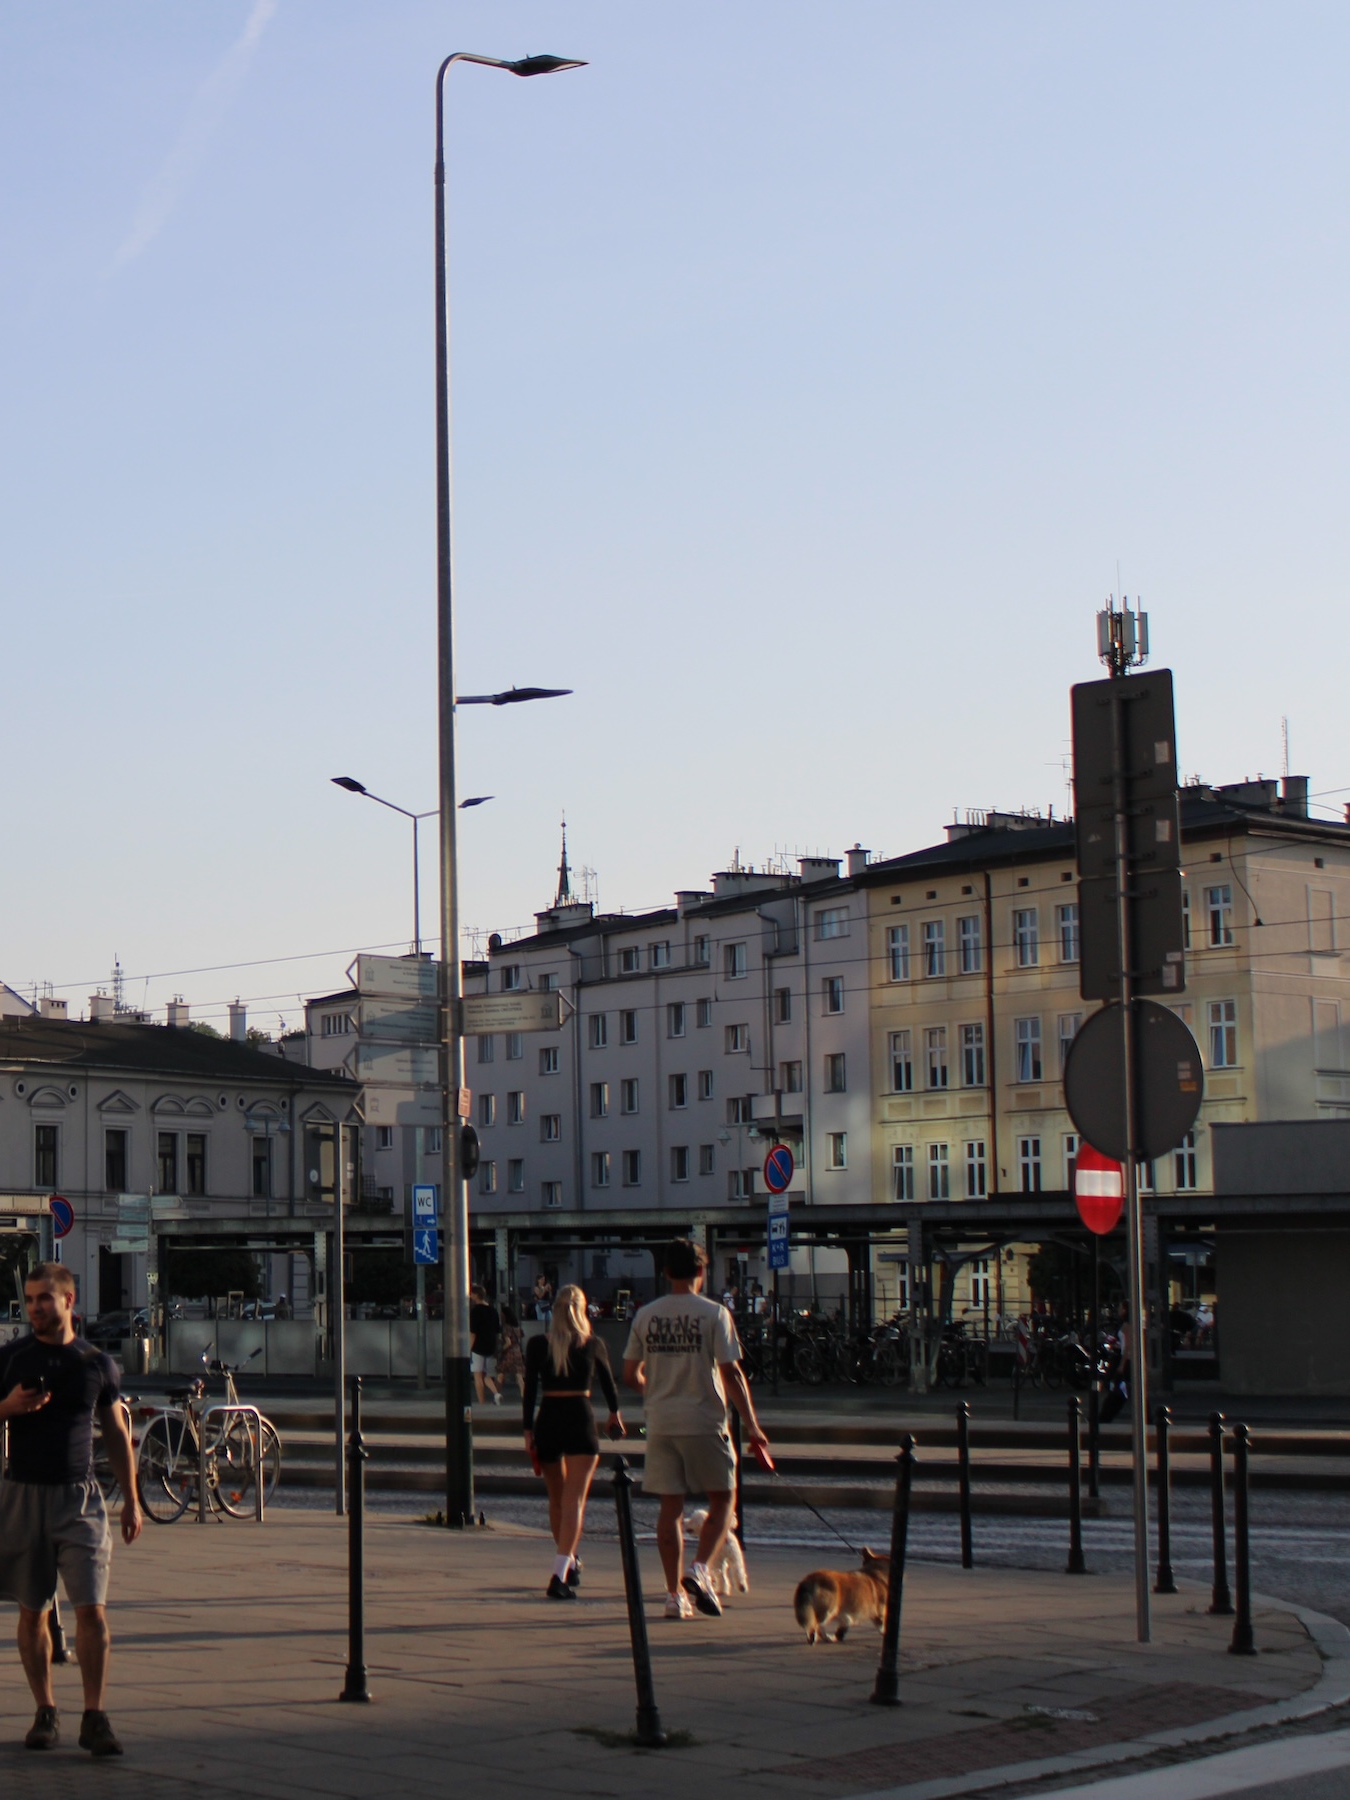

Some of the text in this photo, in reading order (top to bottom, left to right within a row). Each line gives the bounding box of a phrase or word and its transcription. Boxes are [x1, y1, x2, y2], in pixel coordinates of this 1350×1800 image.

[417, 1197, 432, 1208] WC
[772, 1255, 785, 1266] BUS
[645, 1333, 703, 1345] CREATIVE
[646, 1345, 702, 1354] COMMUNITY
